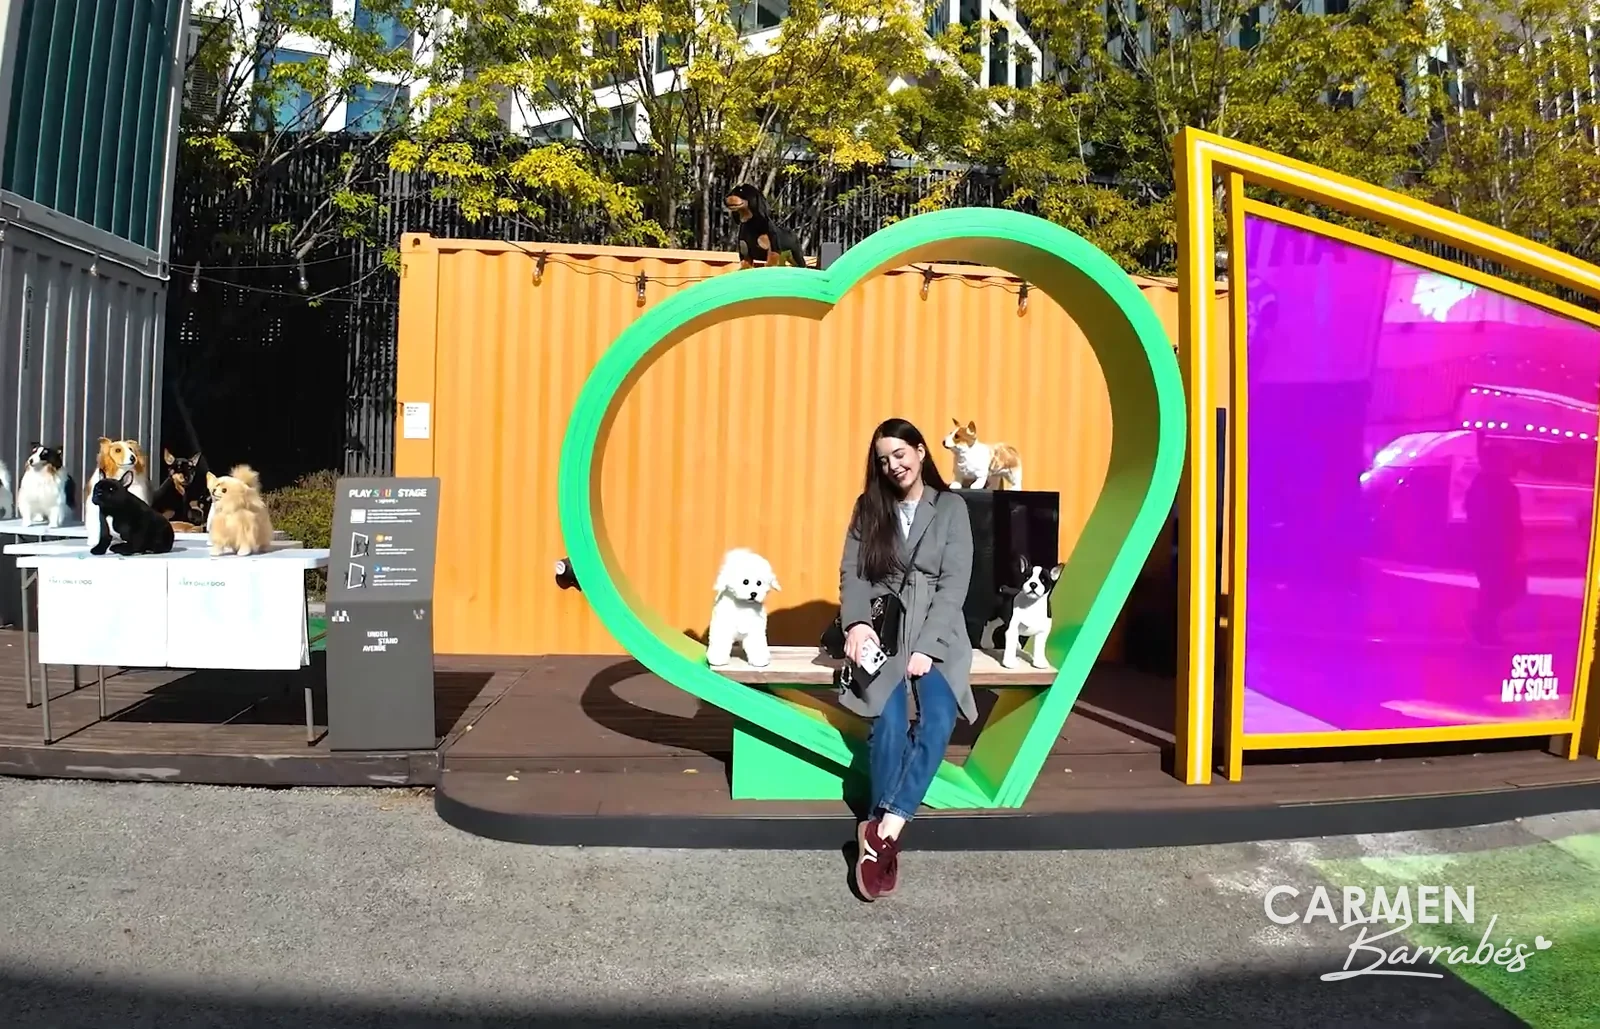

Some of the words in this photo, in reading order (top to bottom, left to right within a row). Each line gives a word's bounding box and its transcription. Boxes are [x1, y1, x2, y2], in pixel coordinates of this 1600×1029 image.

[348, 488, 373, 498] PLAY
[372, 488, 396, 498] SU
[397, 488, 428, 498] STAGE
[366, 630, 389, 638] UNDER
[378, 637, 399, 646] STAND
[362, 644, 387, 653] AVENUE
[1501, 678, 1525, 703] MY
[1524, 677, 1560, 702] SOUL
